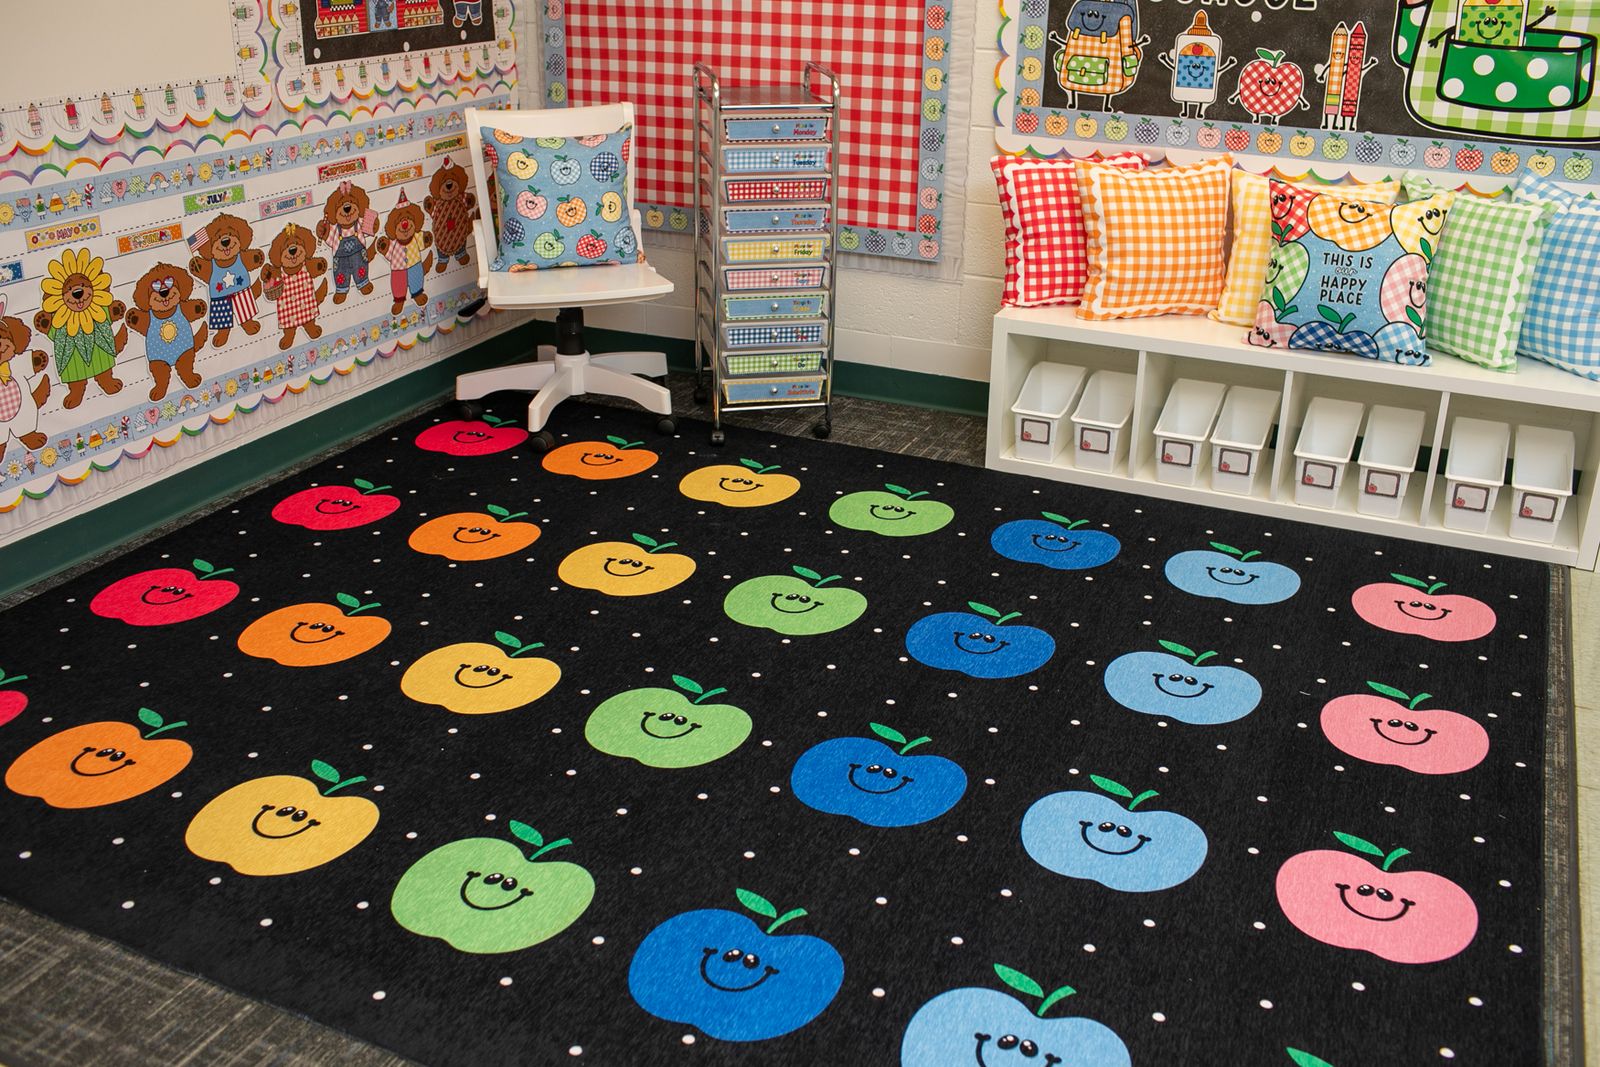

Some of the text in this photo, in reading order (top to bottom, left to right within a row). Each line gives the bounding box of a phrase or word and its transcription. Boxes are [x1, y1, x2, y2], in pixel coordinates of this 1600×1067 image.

[206, 192, 223, 205] JULY
[56, 226, 73, 240] MAY
[1323, 252, 1373, 269] THIS IS
[1335, 267, 1358, 276] our
[1321, 275, 1367, 291] HAPPY
[1320, 289, 1363, 305] PLACE
